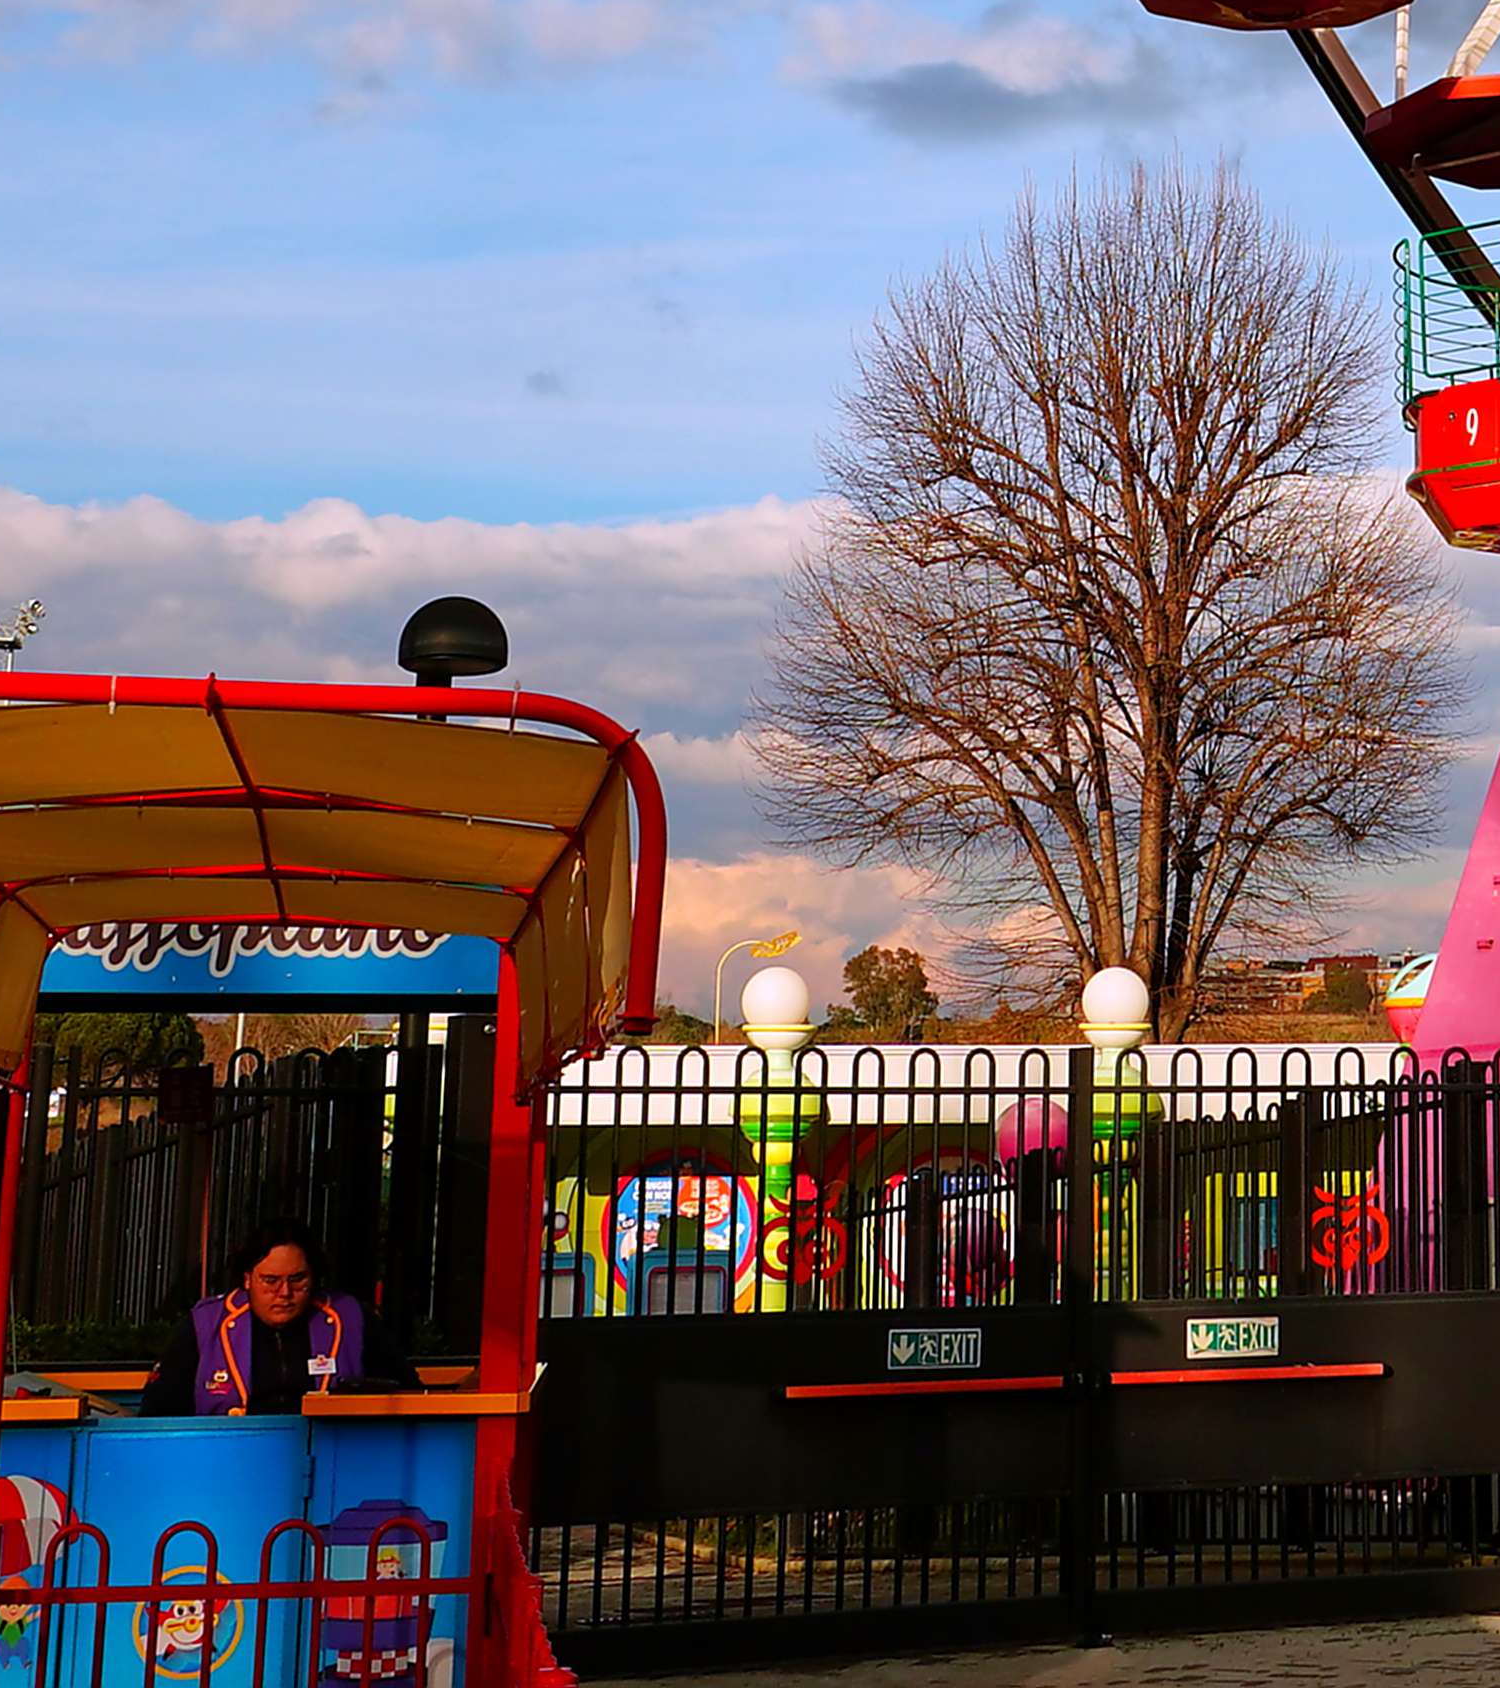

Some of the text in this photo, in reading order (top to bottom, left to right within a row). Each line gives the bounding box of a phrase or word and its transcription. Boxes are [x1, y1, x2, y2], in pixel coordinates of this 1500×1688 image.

[1464, 407, 1480, 447] 9
[941, 1333, 977, 1364] EXIT
[1241, 1321, 1274, 1351] EXIT
